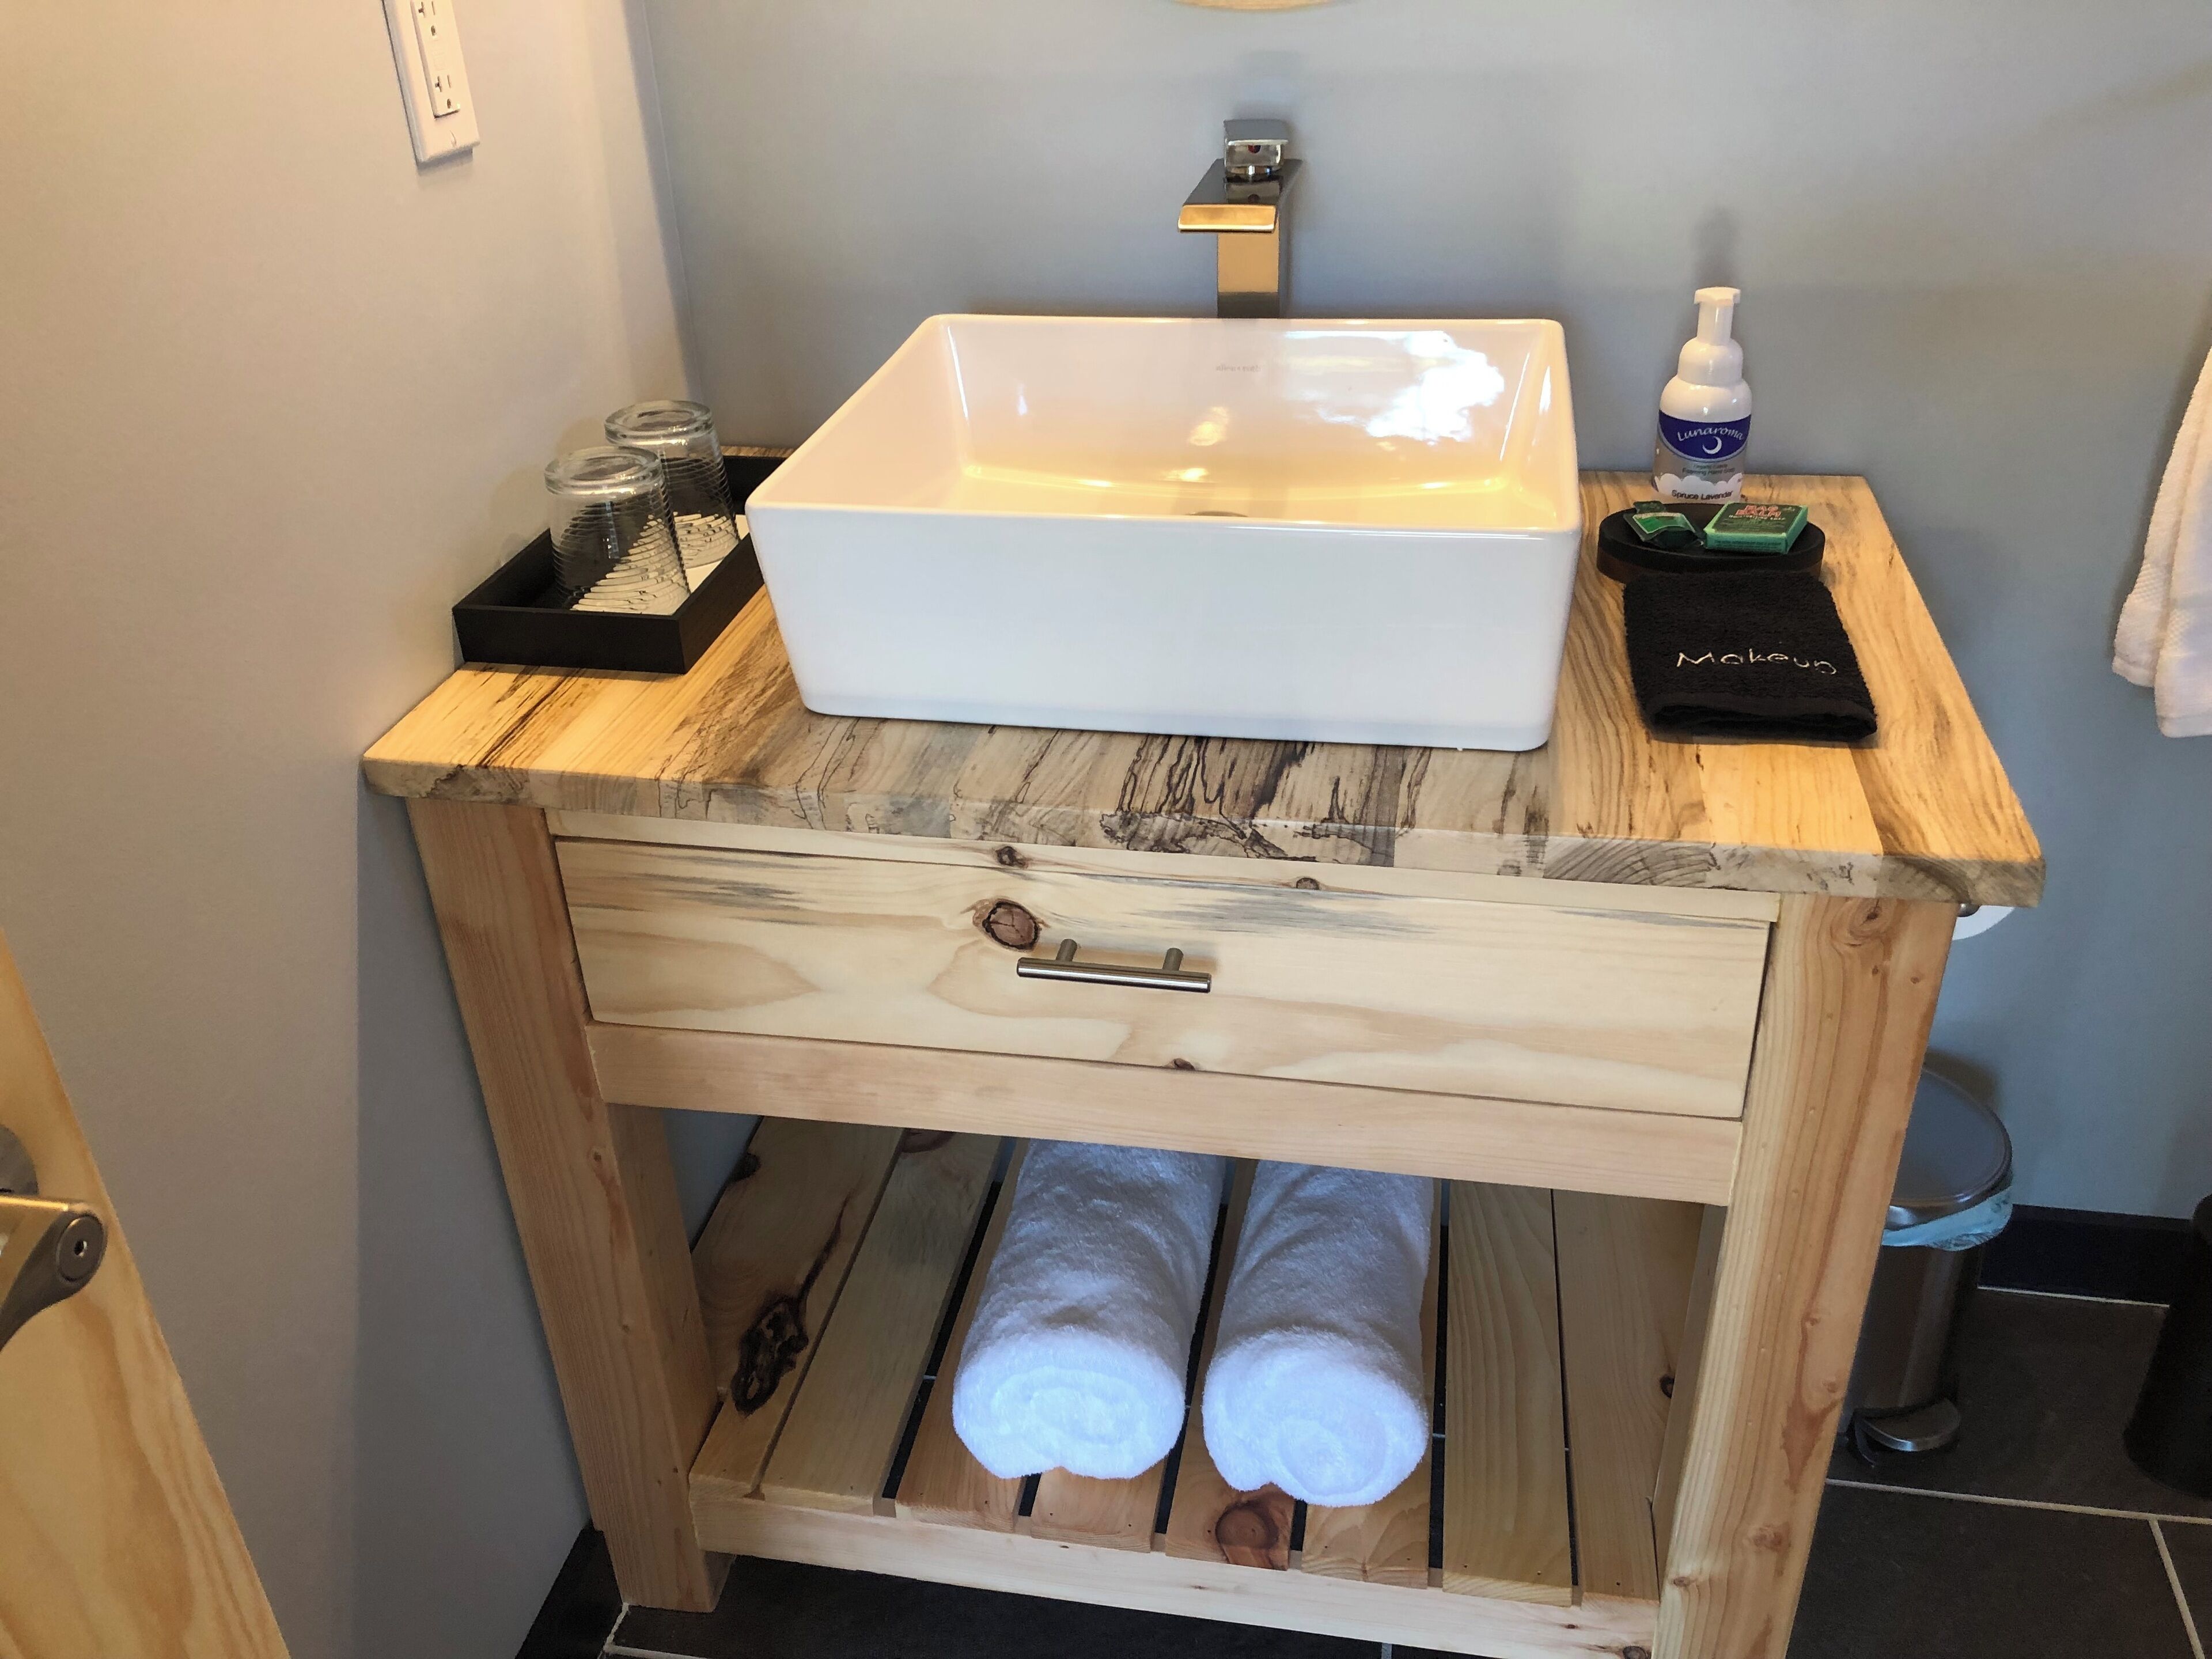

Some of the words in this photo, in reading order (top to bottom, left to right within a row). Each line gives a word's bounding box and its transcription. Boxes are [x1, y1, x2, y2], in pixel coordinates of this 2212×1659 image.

[1677, 427, 1743, 441] Lunaroma
[1672, 490, 1699, 499] Spruce
[1701, 491, 1733, 500] Lavender
